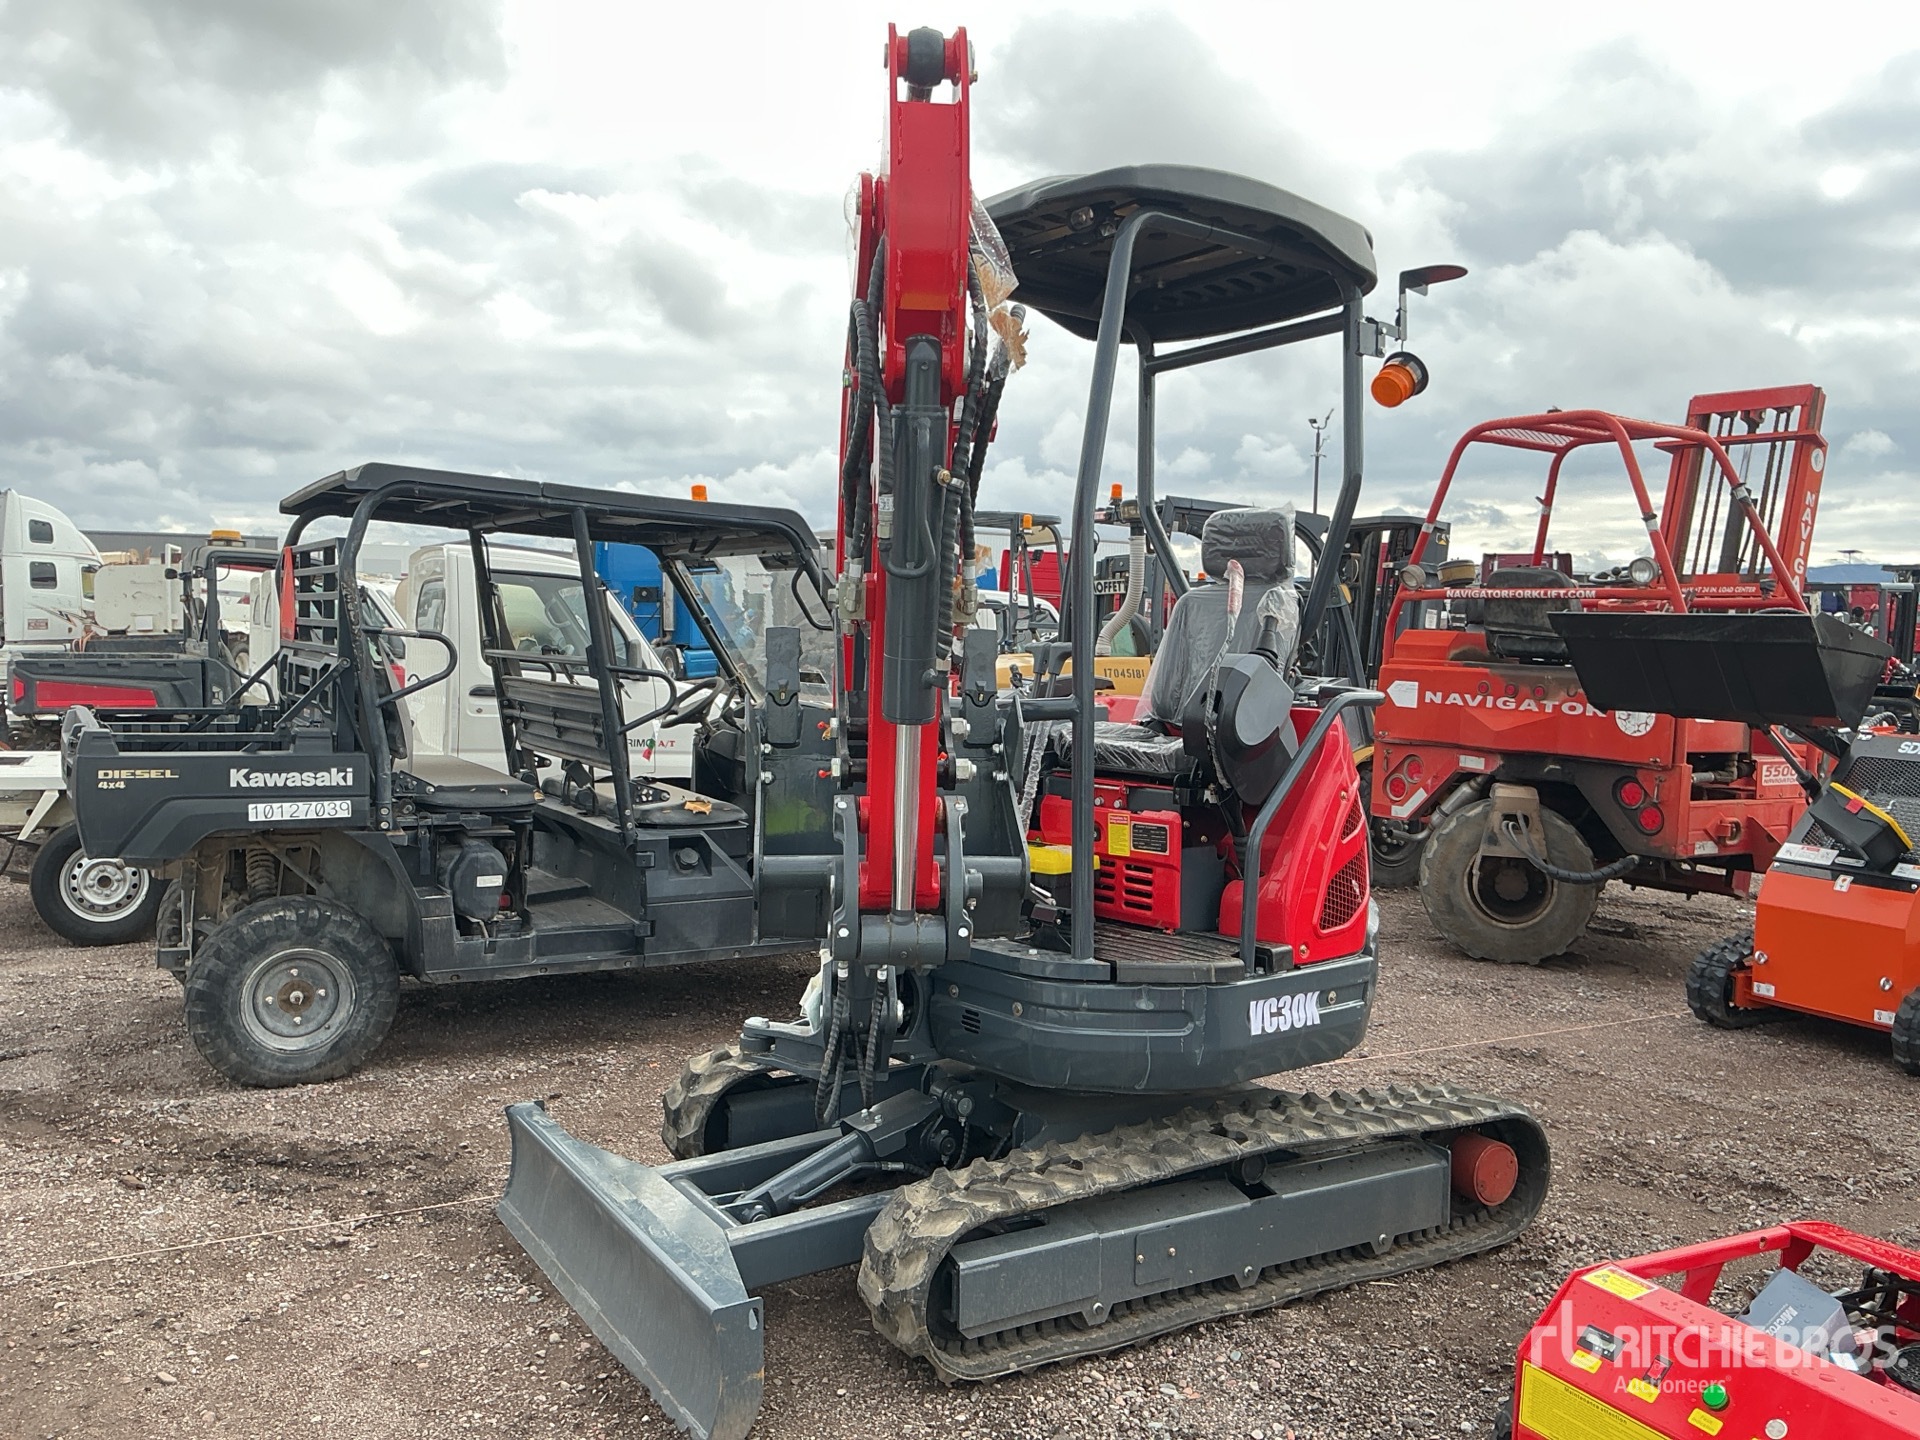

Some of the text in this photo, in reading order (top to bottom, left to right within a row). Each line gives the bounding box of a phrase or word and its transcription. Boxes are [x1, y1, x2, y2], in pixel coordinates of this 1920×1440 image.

[1094, 580, 1128, 593] OFFETT
[1446, 589, 1596, 599] NAVIGATORFORKLIFT.COM
[658, 740, 676, 749] A/T
[97, 769, 179, 779] DIESEL
[229, 768, 353, 788] Kawasaki
[97, 781, 126, 789] 4x4
[250, 801, 351, 820] 10127039
[1249, 990, 1320, 1036] VC30K
